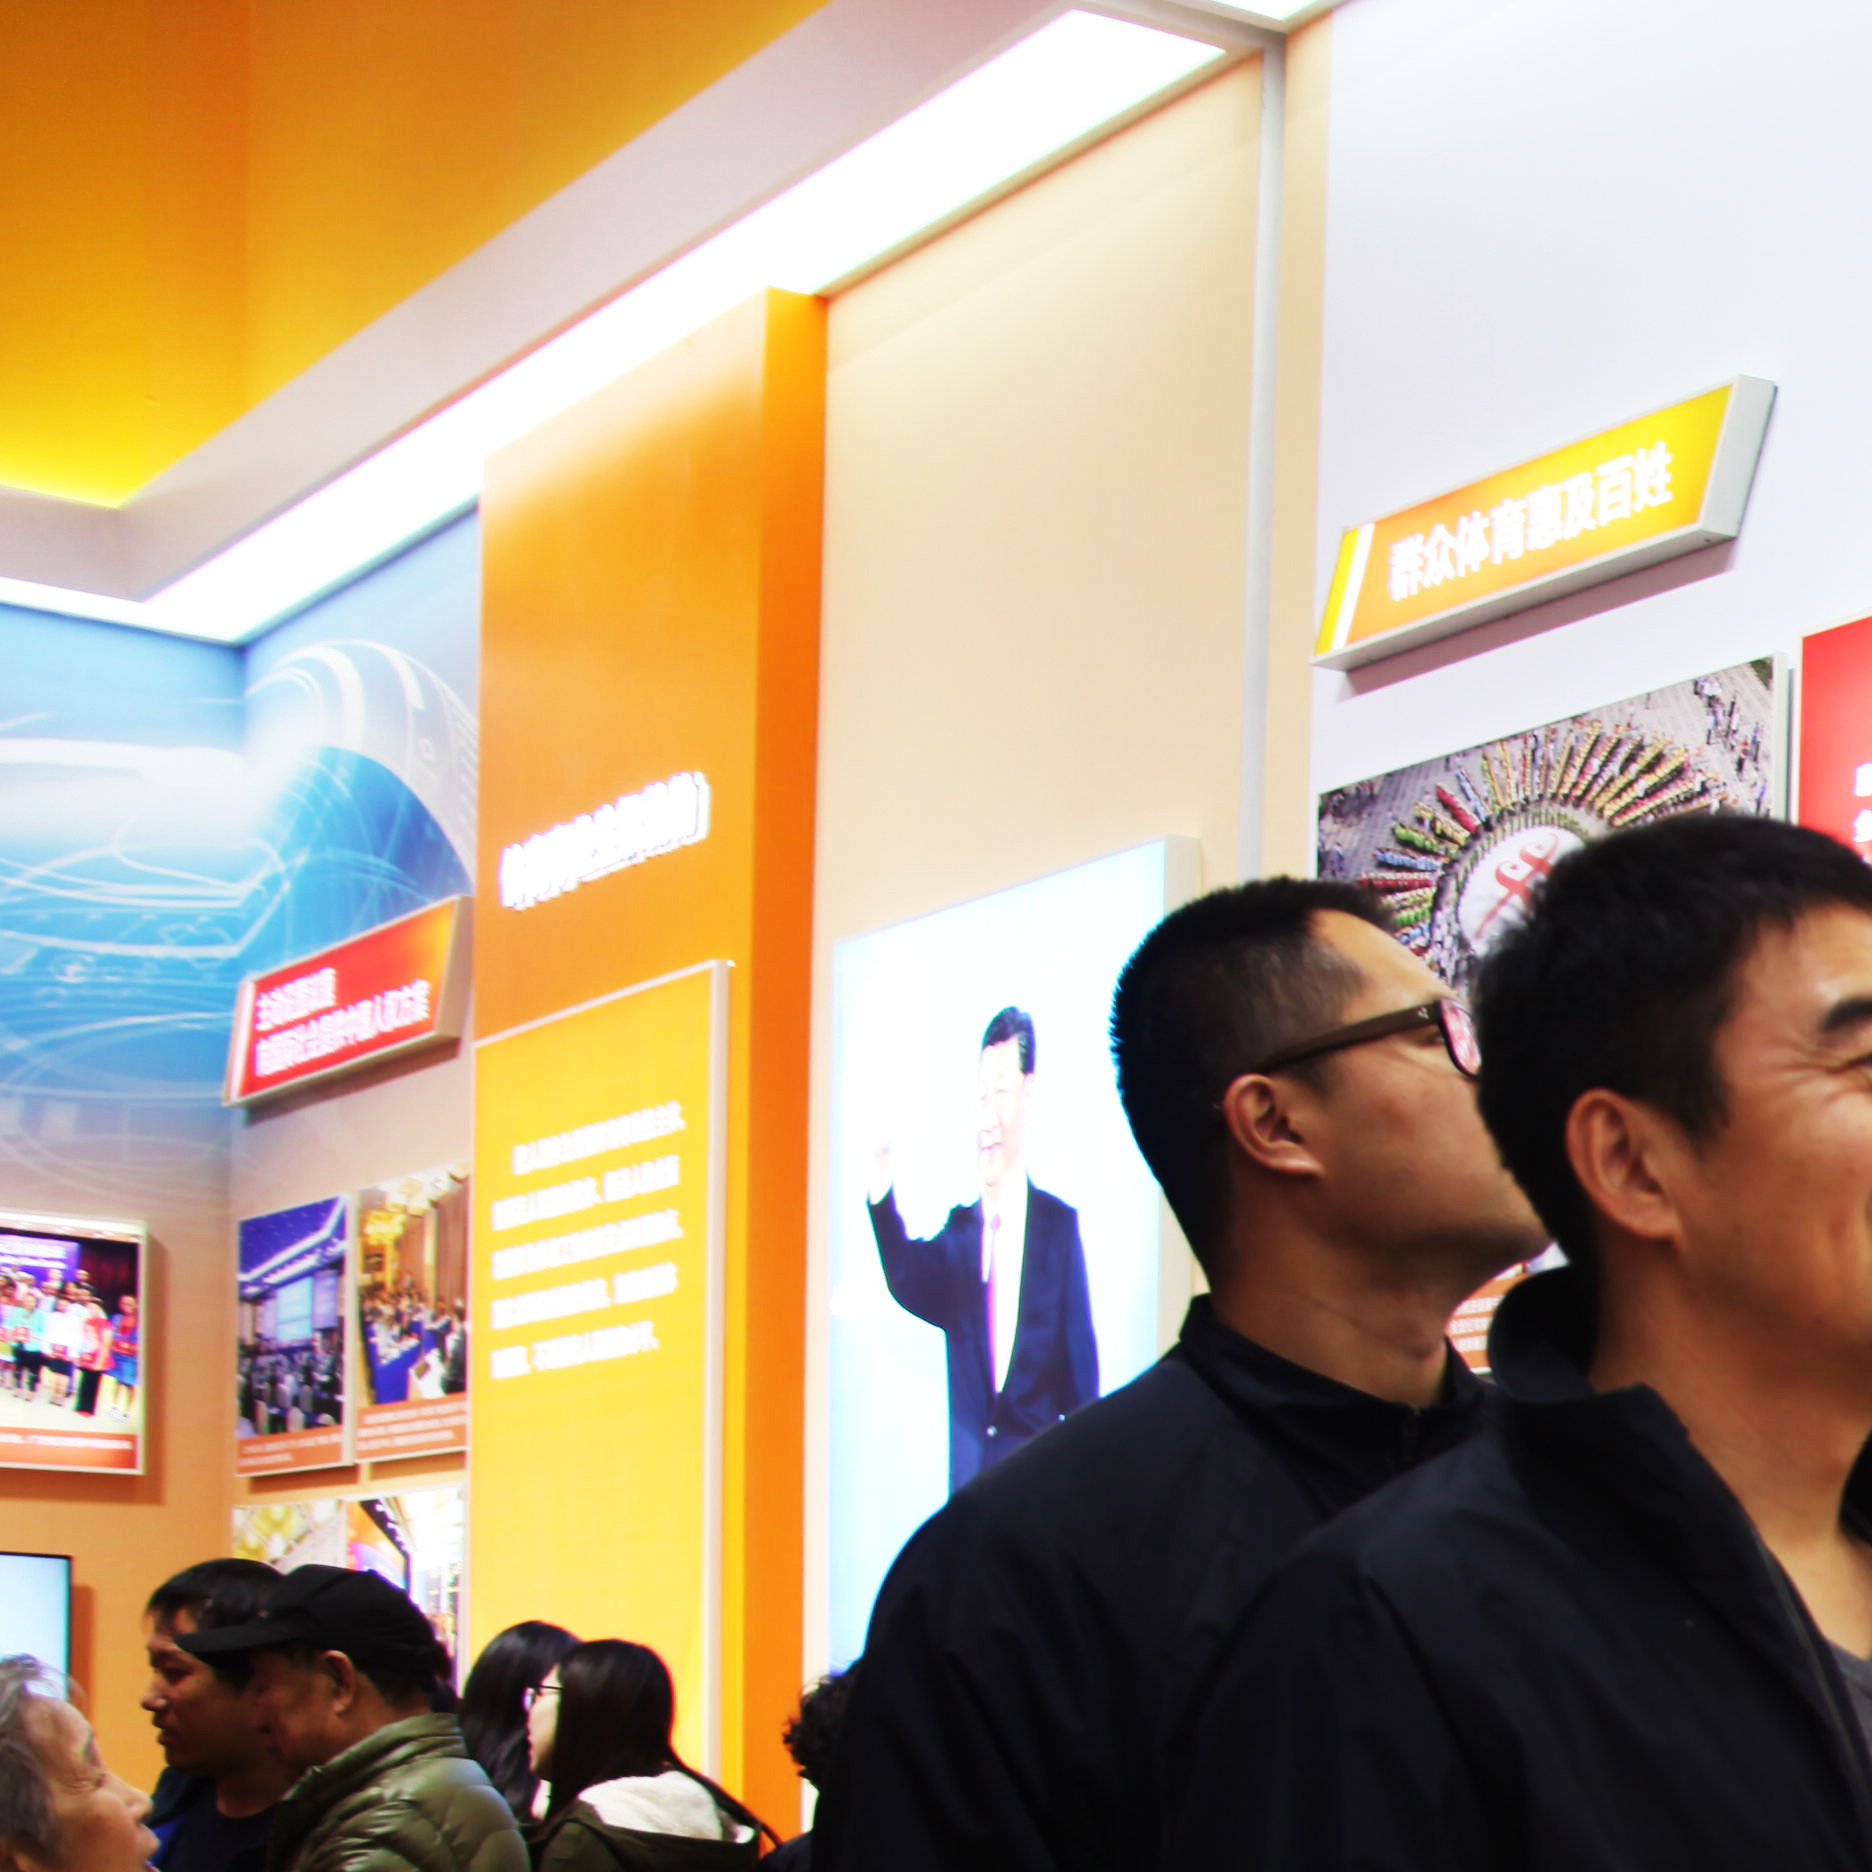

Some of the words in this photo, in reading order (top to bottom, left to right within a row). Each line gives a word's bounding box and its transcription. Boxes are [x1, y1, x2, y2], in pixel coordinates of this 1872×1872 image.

[1388, 440, 1673, 603] 群众体育惠及百姓
